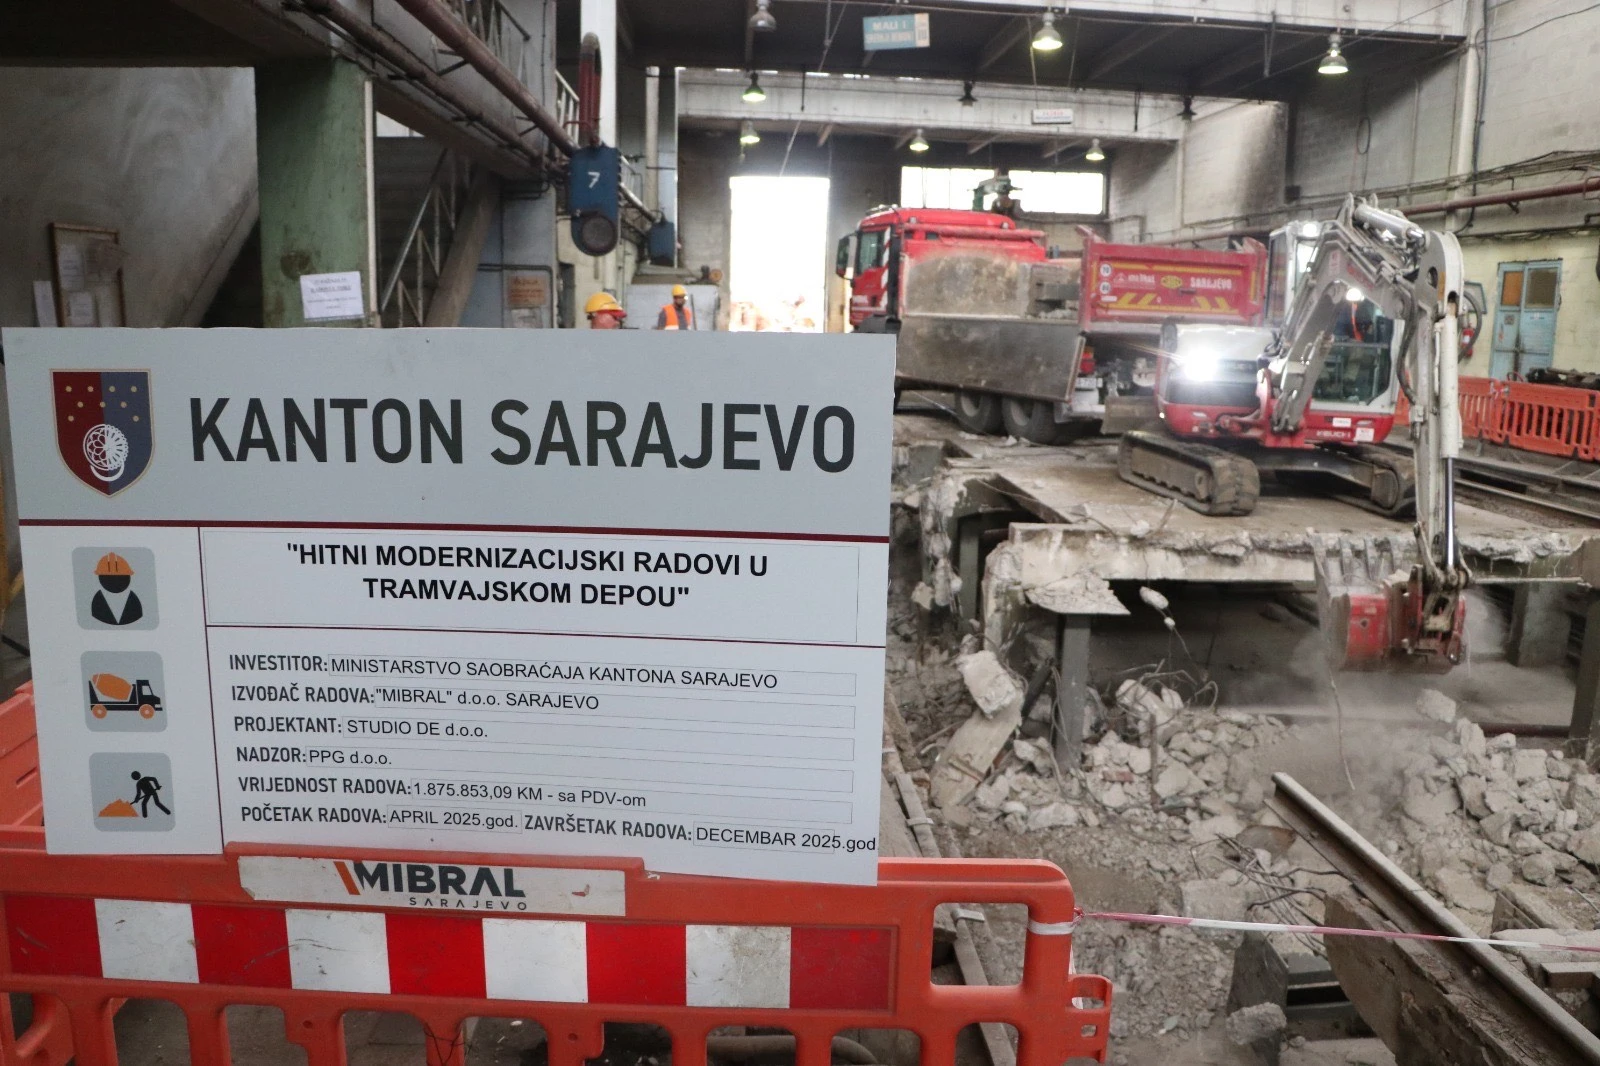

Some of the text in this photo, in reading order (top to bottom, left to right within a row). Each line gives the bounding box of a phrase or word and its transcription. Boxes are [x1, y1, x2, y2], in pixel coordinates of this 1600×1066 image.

[588, 171, 600, 189] 7
[190, 397, 855, 473] KANTON SARAJEVO
[287, 542, 768, 577] "HITNI MODERNIZACIJSKI RADOVI U
[363, 578, 689, 607] TRAMVAJSKOM DEPOU"
[229, 654, 778, 689] INVESTITOR: MINISTARSTVO SAOBRAĆAJA KANTONA SARAJEVO
[231, 682, 600, 710] IZVOĐAČ RADOVA: "MIBRAL" d.o.o. SARAJEVO
[234, 716, 488, 738] PROJEKTANT: STUDIO DE d.o.o.
[236, 747, 392, 765] NADZOR: PPG d.o.o.
[238, 776, 338, 793] VRIJEDNOST
[343, 779, 411, 795] RADOVA:
[414, 782, 512, 801] 1.875.853,09
[517, 786, 543, 801] KM
[558, 790, 576, 803] sa
[581, 790, 647, 807] PDV-om
[241, 803, 877, 853] POČETAK RADOVA: APRIL 2025.god. ZAVRŠETAK RADOVA: DECEMBAR 2025.god
[353, 862, 526, 898] MIBRAL
[409, 897, 527, 911] SARAJEVO
